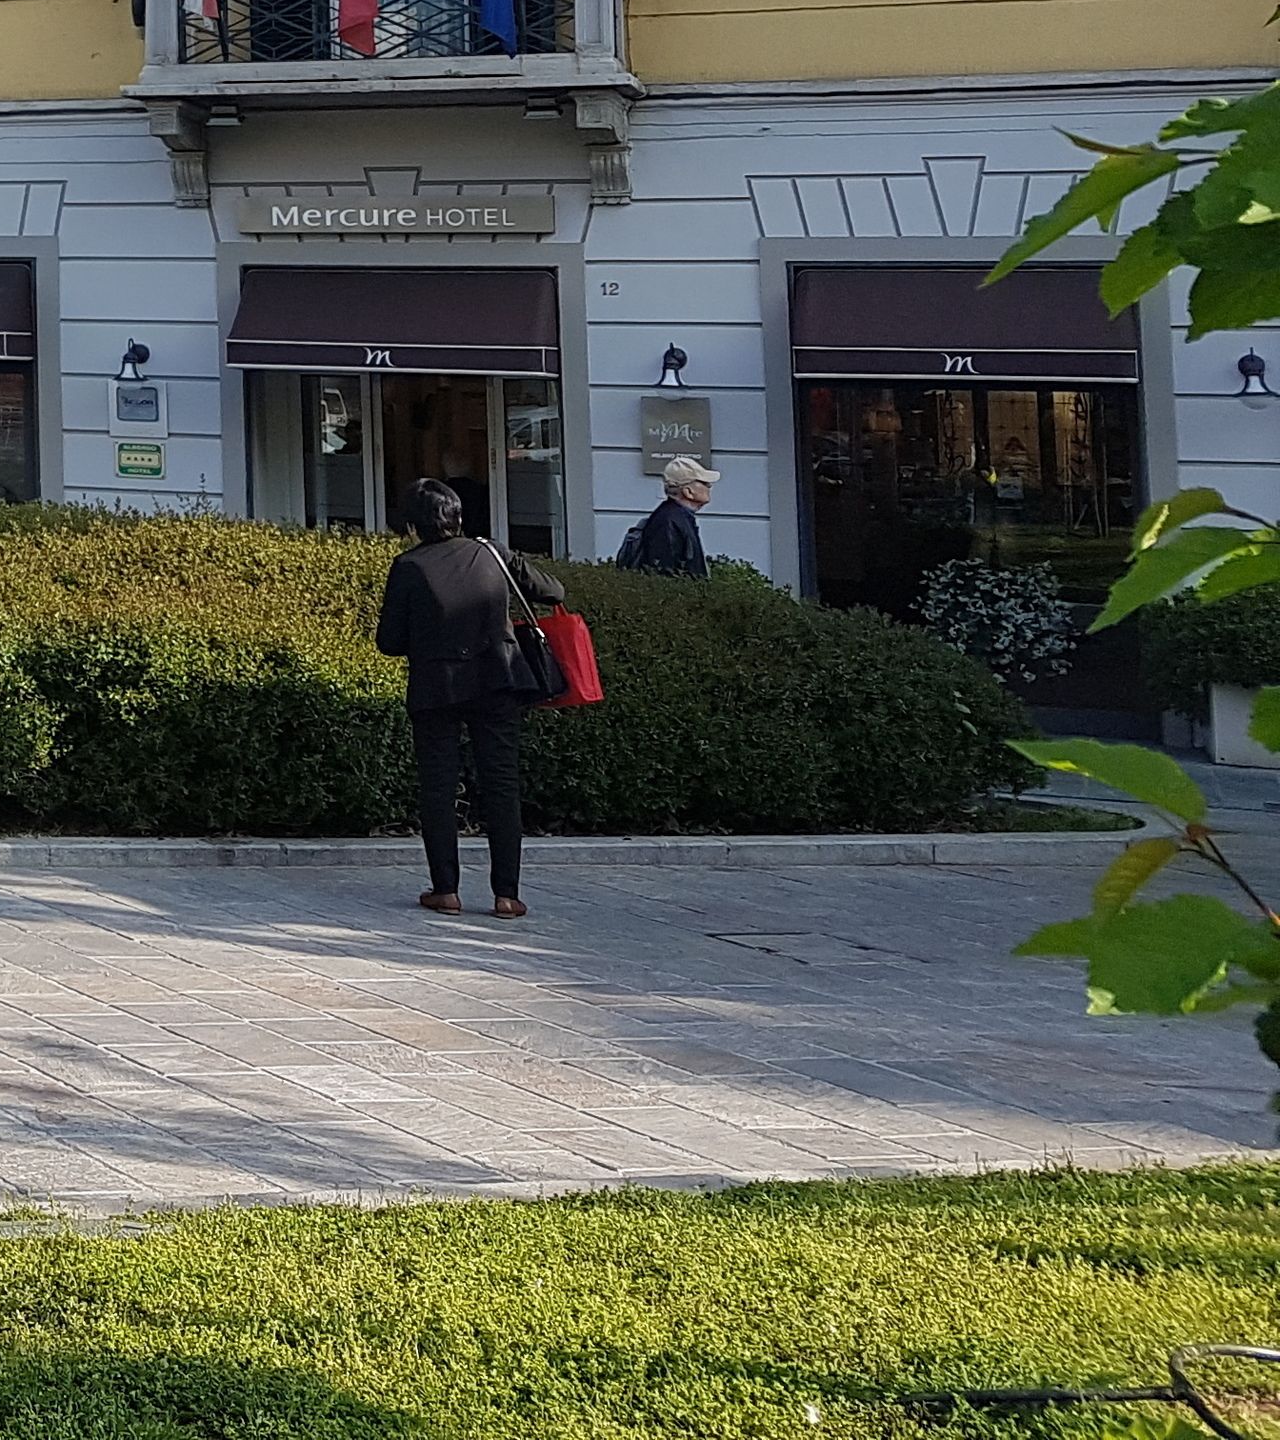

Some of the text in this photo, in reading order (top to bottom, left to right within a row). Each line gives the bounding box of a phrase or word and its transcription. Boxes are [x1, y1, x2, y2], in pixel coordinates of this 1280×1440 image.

[270, 205, 516, 228] Mercure HOTEL
[600, 282, 620, 297] 12
